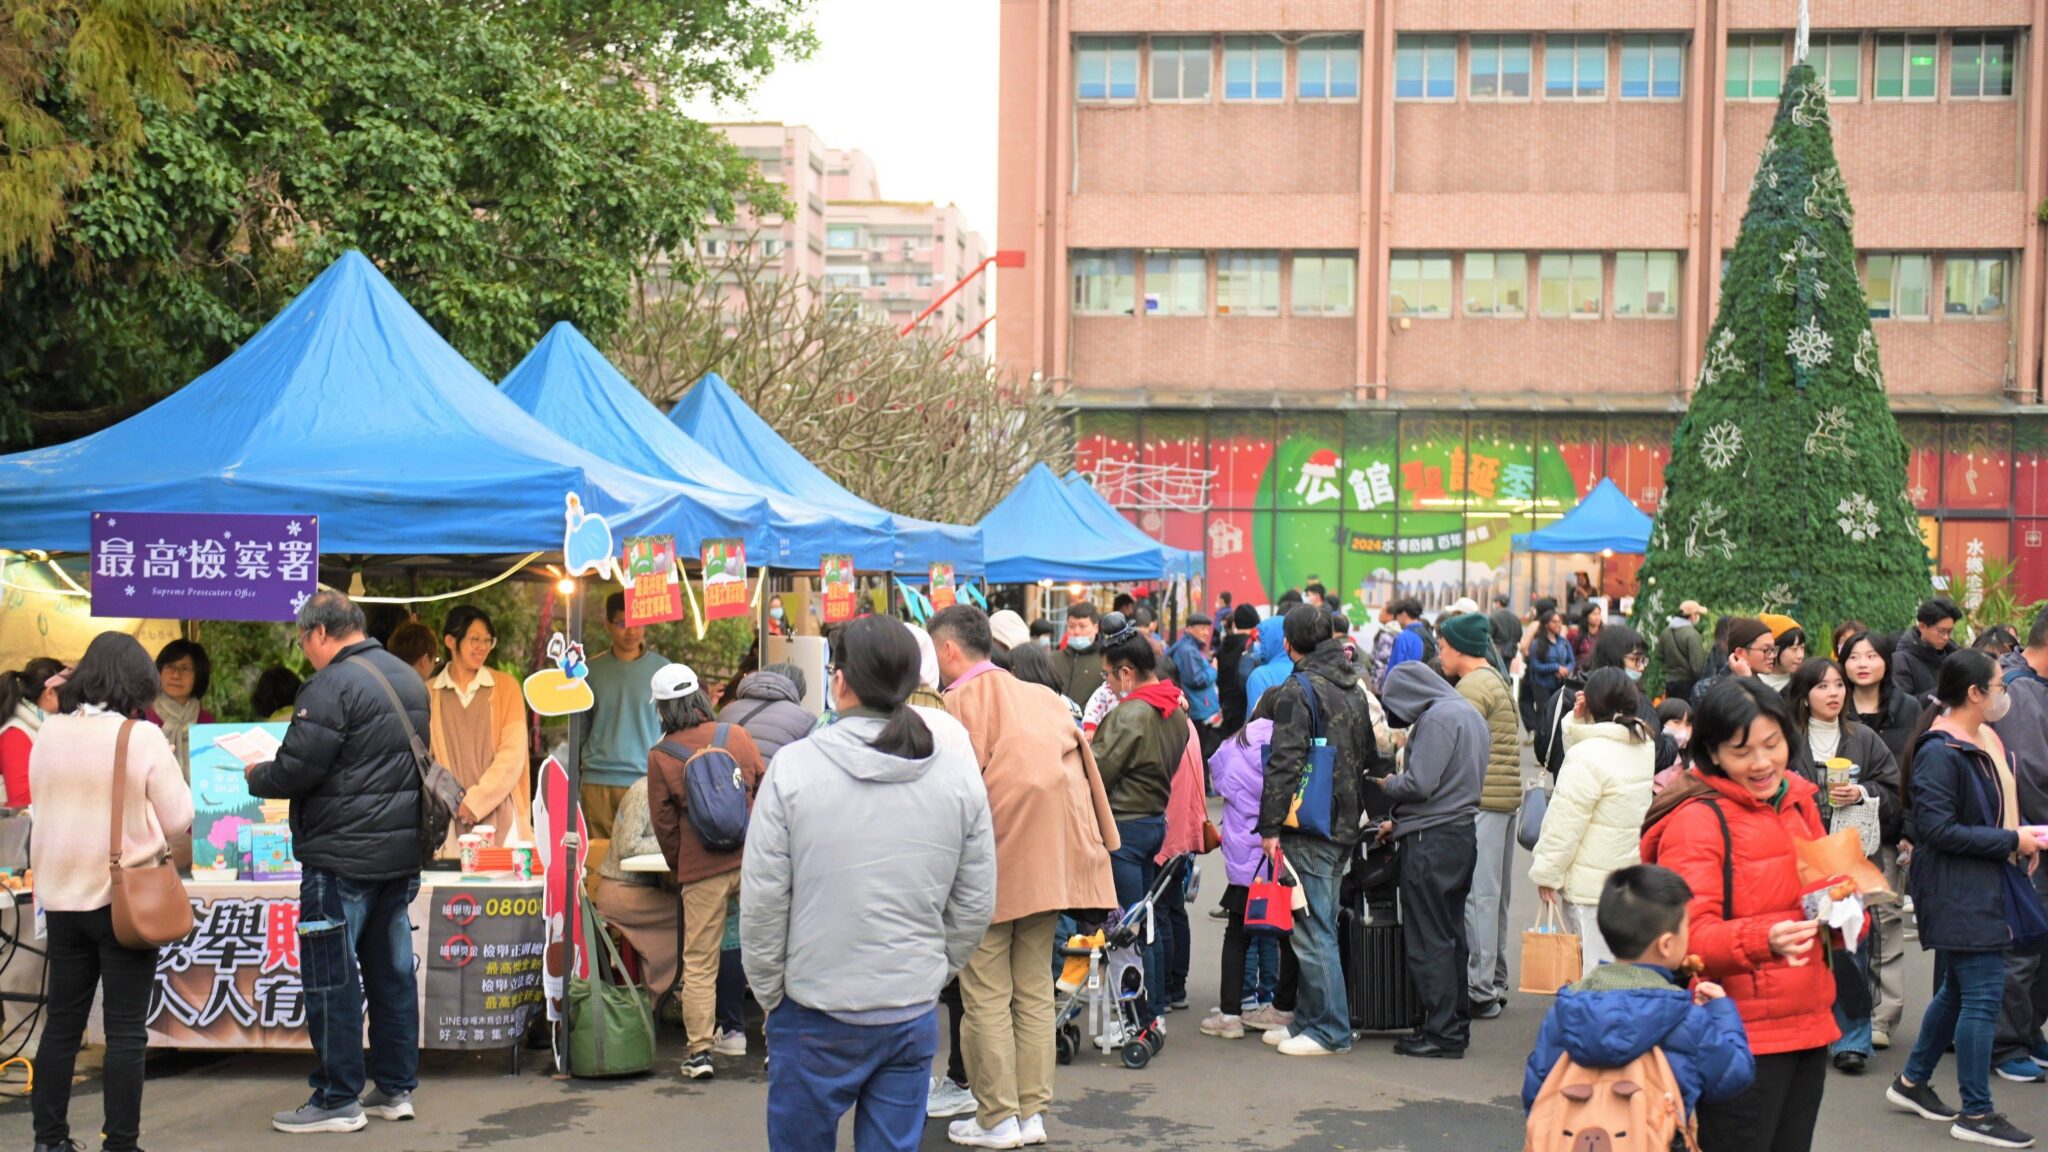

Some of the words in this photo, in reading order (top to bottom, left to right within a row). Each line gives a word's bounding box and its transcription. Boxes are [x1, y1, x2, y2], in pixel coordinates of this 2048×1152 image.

[96, 537, 313, 581] 最高檢察署
[152, 587, 185, 598] Supreme
[188, 588, 232, 598] Prosecutors
[234, 589, 257, 598] Office
